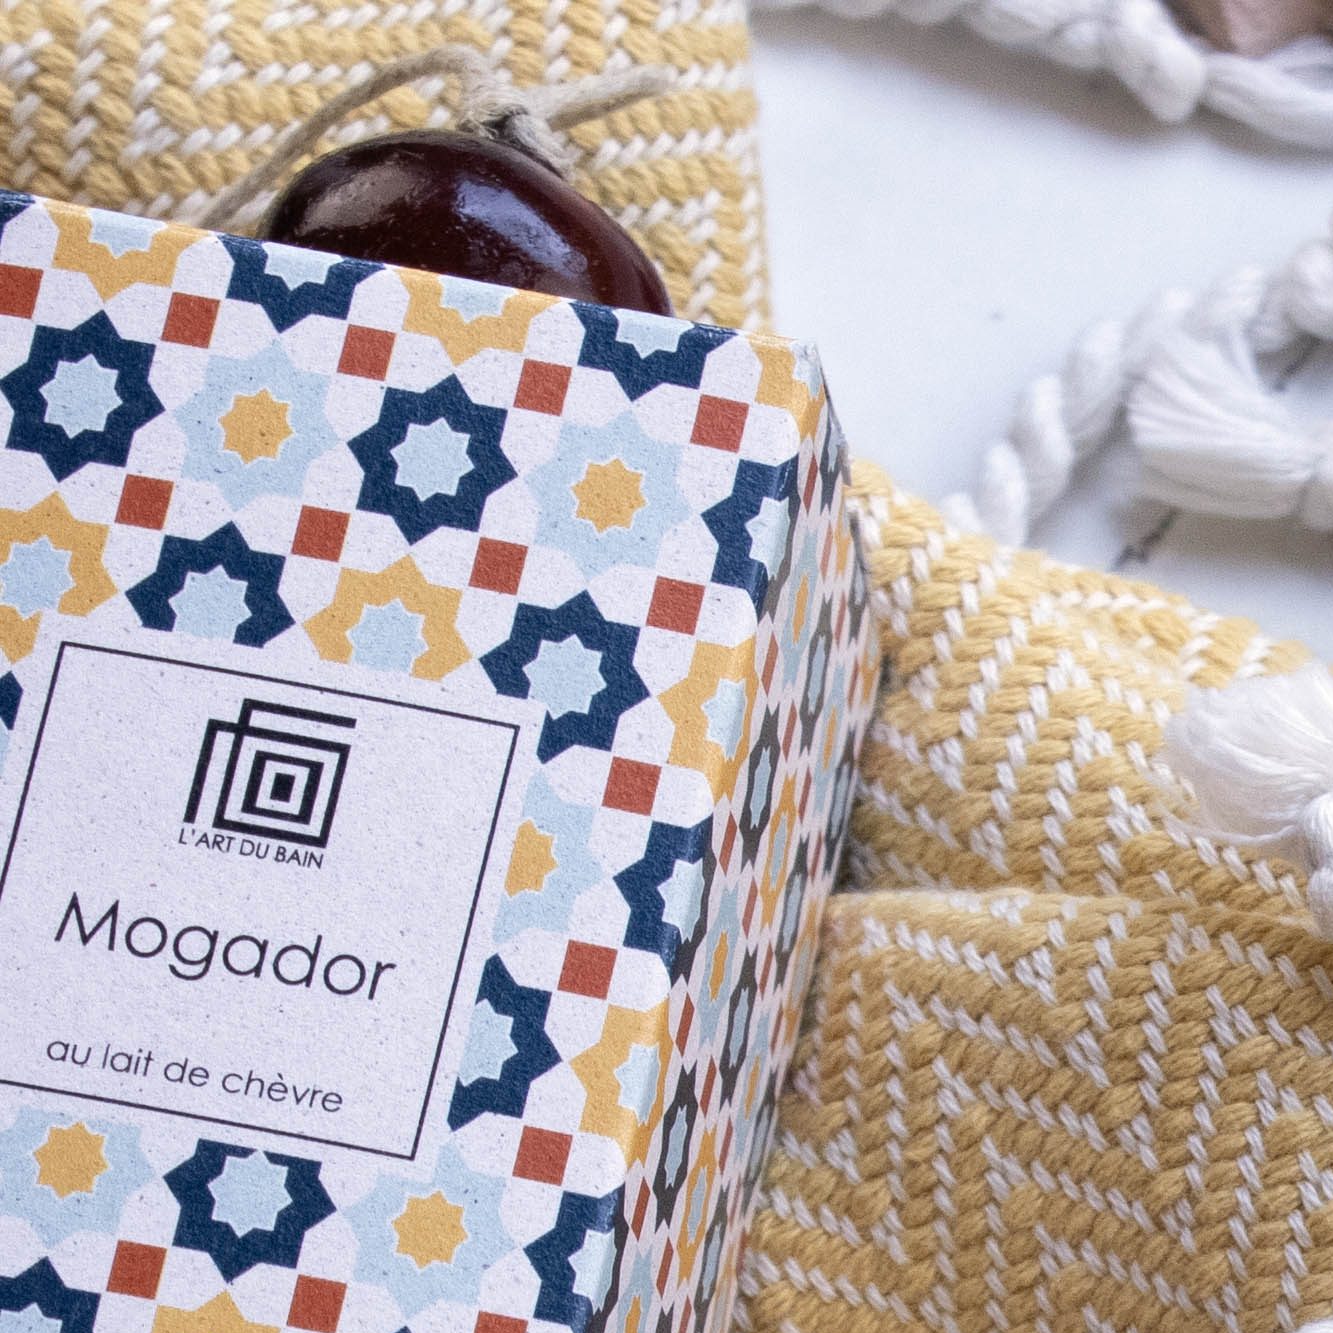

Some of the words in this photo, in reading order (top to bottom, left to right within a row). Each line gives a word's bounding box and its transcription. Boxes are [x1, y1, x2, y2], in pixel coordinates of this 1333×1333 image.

[178, 827, 235, 853] L'ART
[238, 838, 270, 860] DU
[274, 844, 326, 869] BAIN
[54, 891, 397, 1001] Mogador
[46, 1040, 92, 1067] au
[102, 1044, 154, 1077] lait
[163, 1058, 210, 1087] de
[221, 1070, 343, 1113] chèvre
